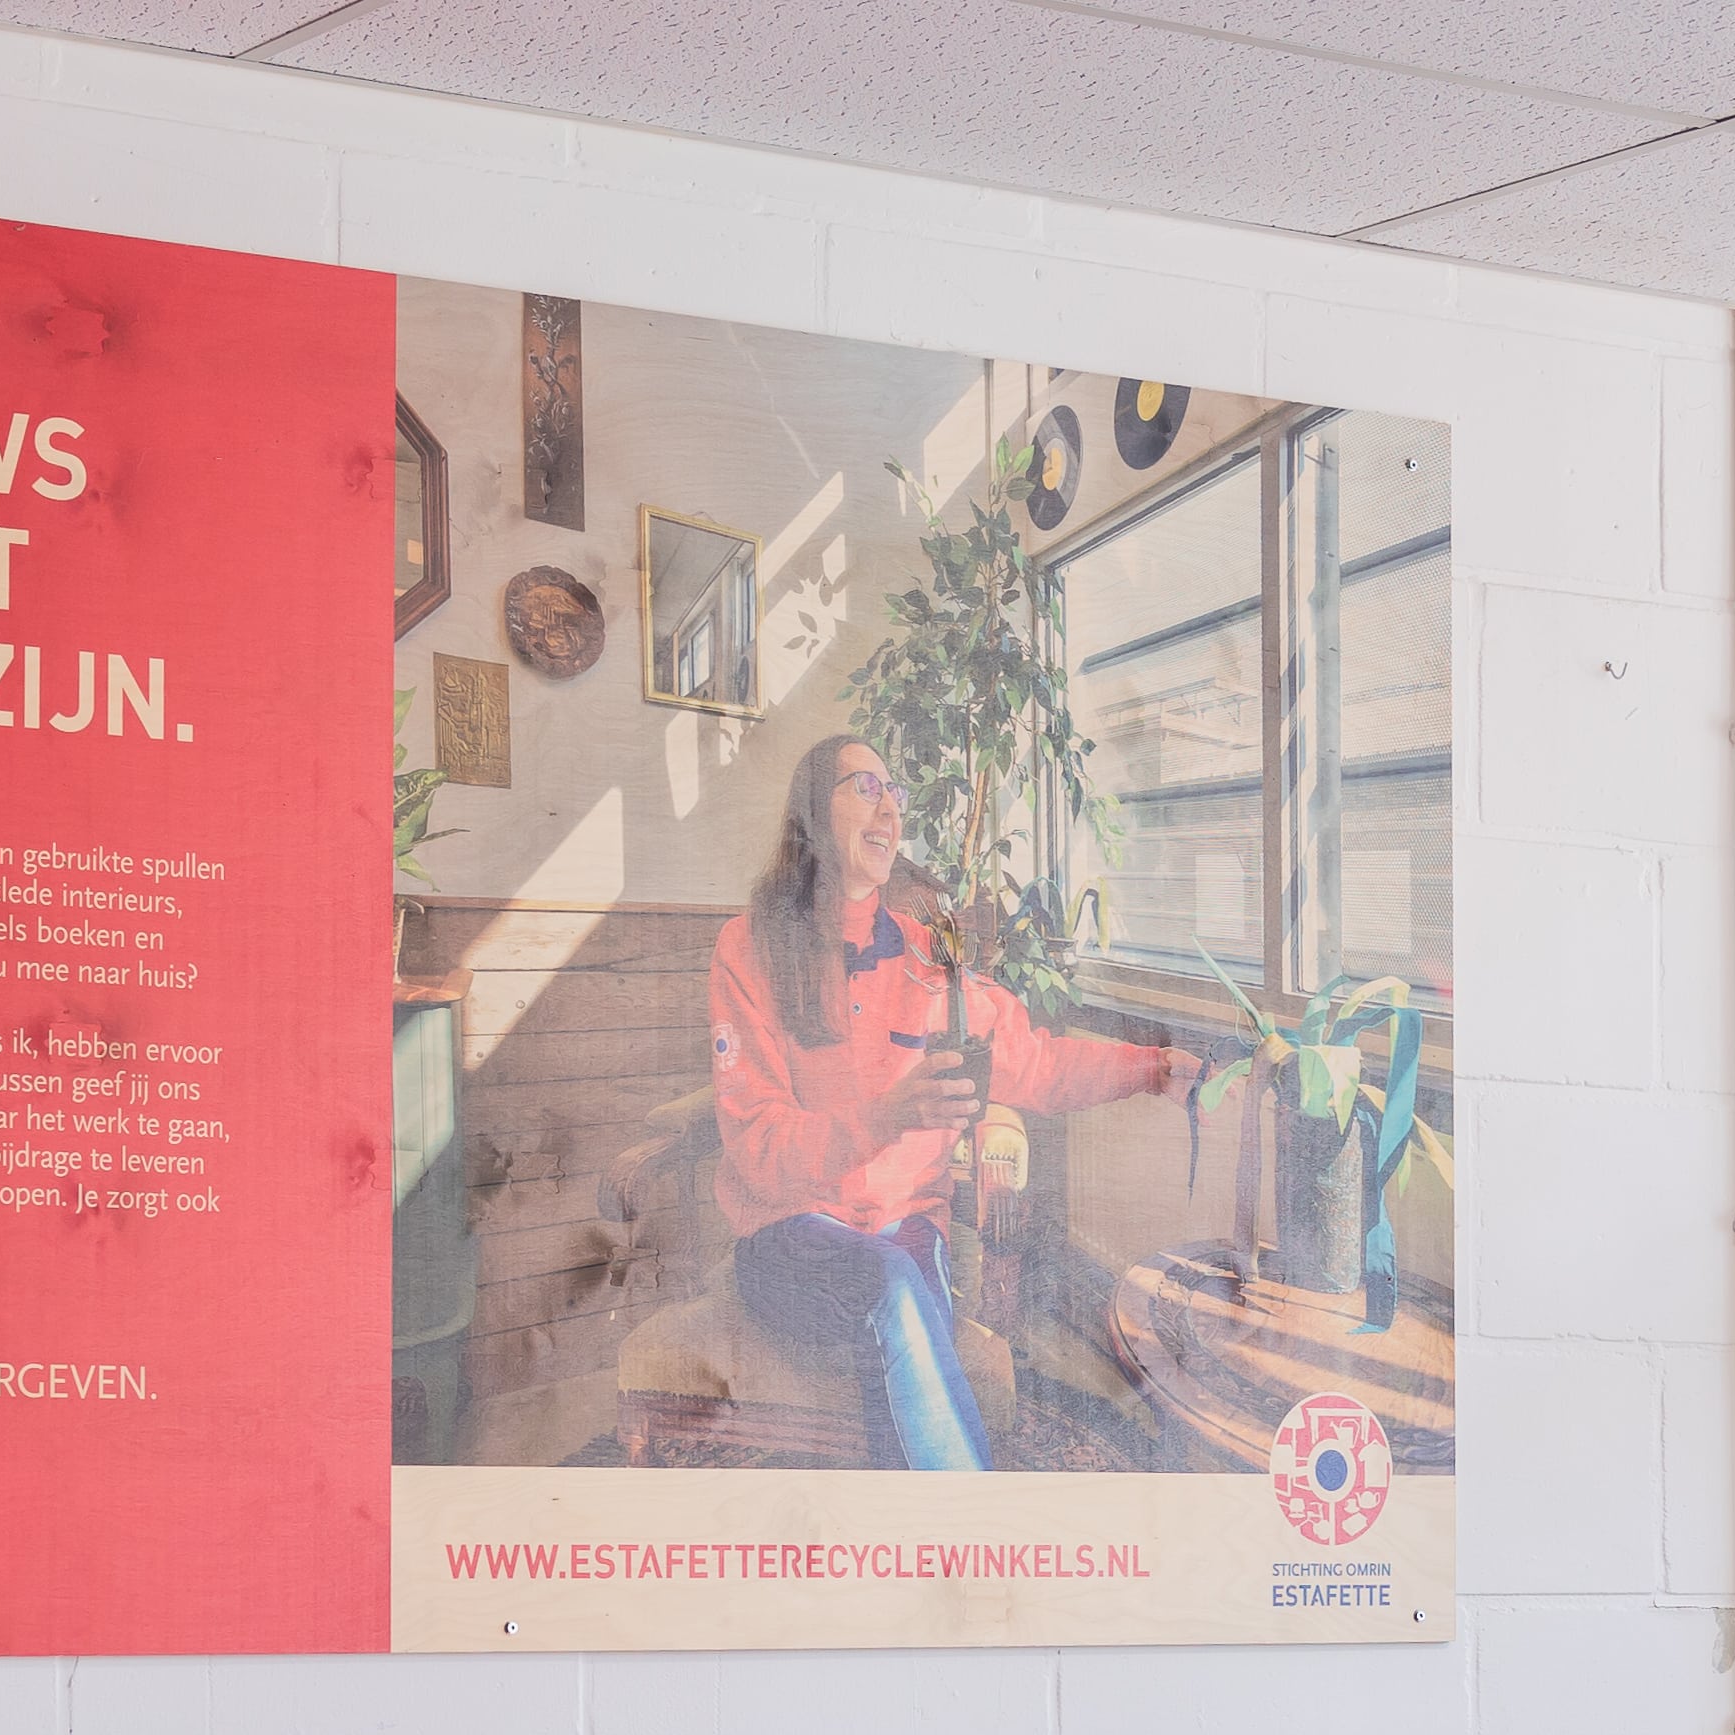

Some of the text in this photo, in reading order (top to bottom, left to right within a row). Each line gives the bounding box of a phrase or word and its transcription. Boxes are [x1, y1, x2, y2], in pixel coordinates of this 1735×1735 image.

[23, 842, 133, 875] gebruikte
[143, 852, 224, 883] spullen
[63, 883, 182, 918] interieurs,
[38, 917, 124, 947] boeken
[135, 932, 163, 950] en
[17, 962, 69, 981] mee
[79, 966, 130, 984] naar
[139, 960, 197, 989] huis?
[13, 1028, 37, 1058] ik,
[49, 1030, 136, 1059] hebben
[146, 1044, 222, 1064] ervoor
[73, 1071, 126, 1103] geef
[130, 1074, 148, 1105] jij
[158, 1082, 200, 1100] ons
[27, 1104, 65, 1131] het
[73, 1108, 129, 1133] werk
[138, 1114, 159, 1135] te
[169, 1120, 229, 1144] gaan,
[90, 1149, 112, 1171] te
[122, 1146, 204, 1174] leveren
[76, 1184, 98, 1213] Je
[107, 1190, 168, 1218] zorgt
[177, 1186, 219, 1211] ook
[445, 1543, 1151, 1580] WWW.ESTAFETTERECYCLEWINKELS.NL
[1272, 1562, 1392, 1577] STICHTING OMRIN
[1272, 1584, 1391, 1607] ESTAFETTE
